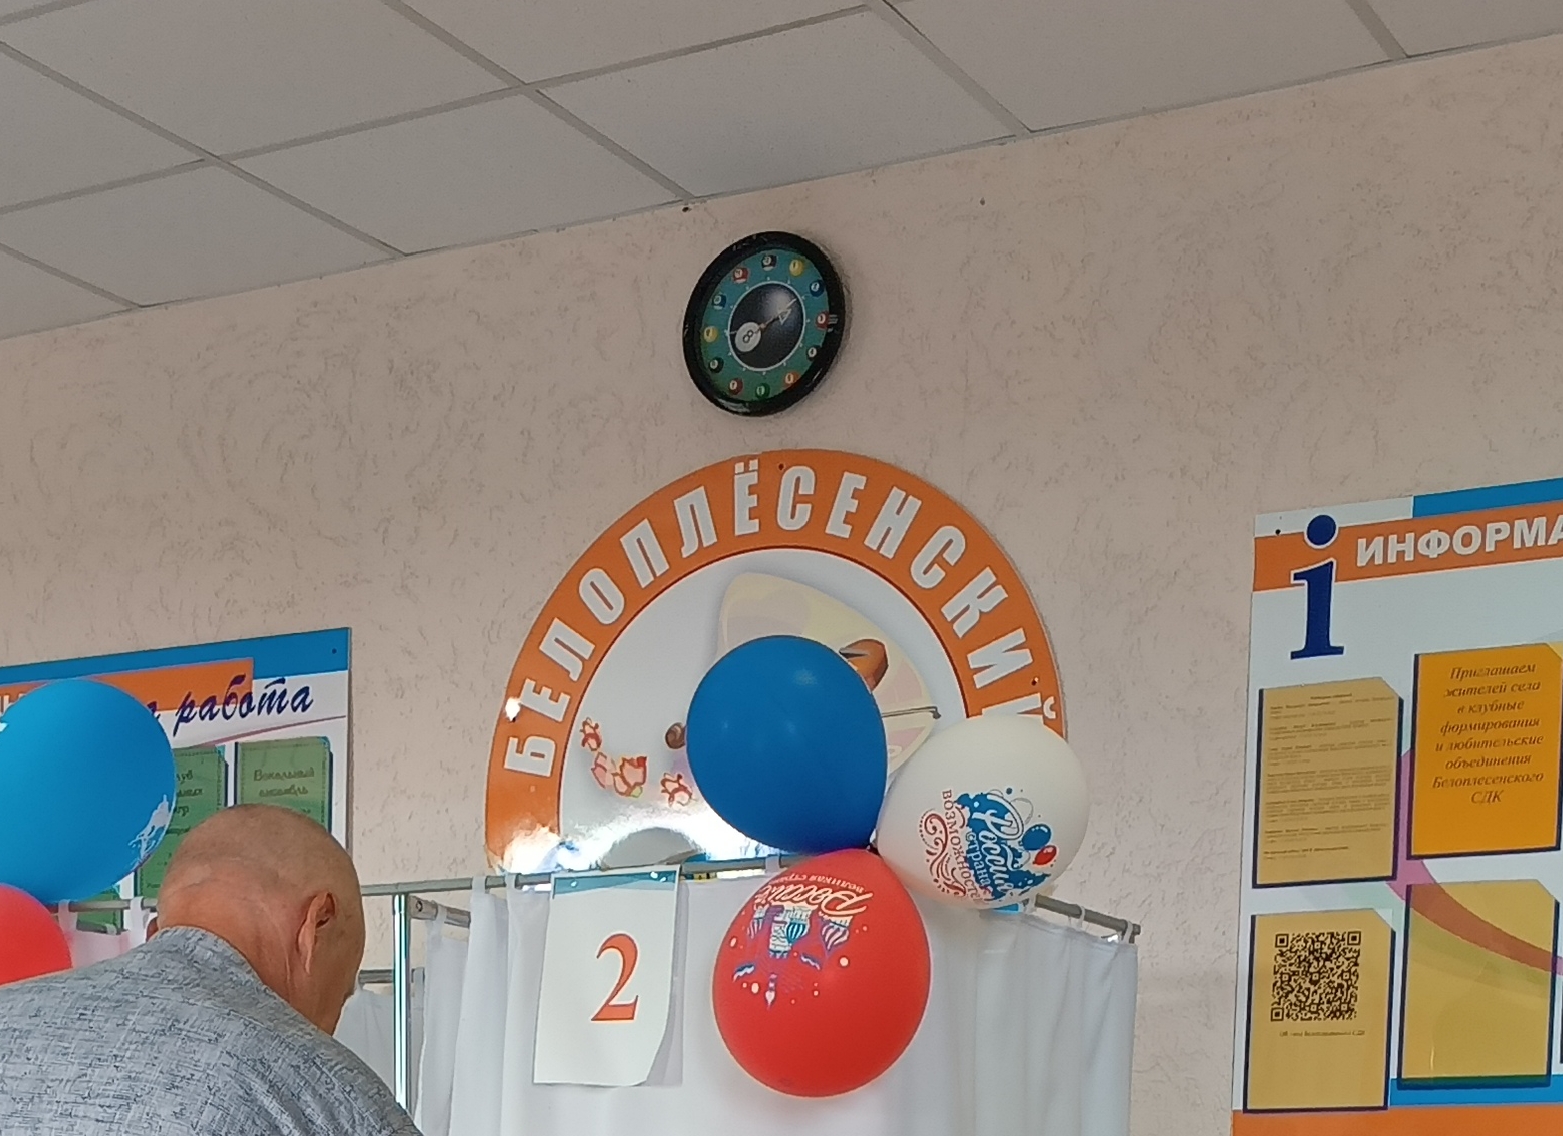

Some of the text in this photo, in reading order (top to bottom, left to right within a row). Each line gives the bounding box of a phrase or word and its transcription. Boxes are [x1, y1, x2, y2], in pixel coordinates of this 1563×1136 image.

[742, 329, 754, 343] 8
[1444, 681, 1541, 697] жителей села
[173, 676, 314, 737] работа
[1457, 700, 1524, 715] в клубные
[1440, 718, 1540, 736] формирования
[1435, 735, 1544, 752] и любительские
[1445, 755, 1532, 770] объединения
[1471, 790, 1504, 805] СДК
[591, 933, 640, 1022] 2
